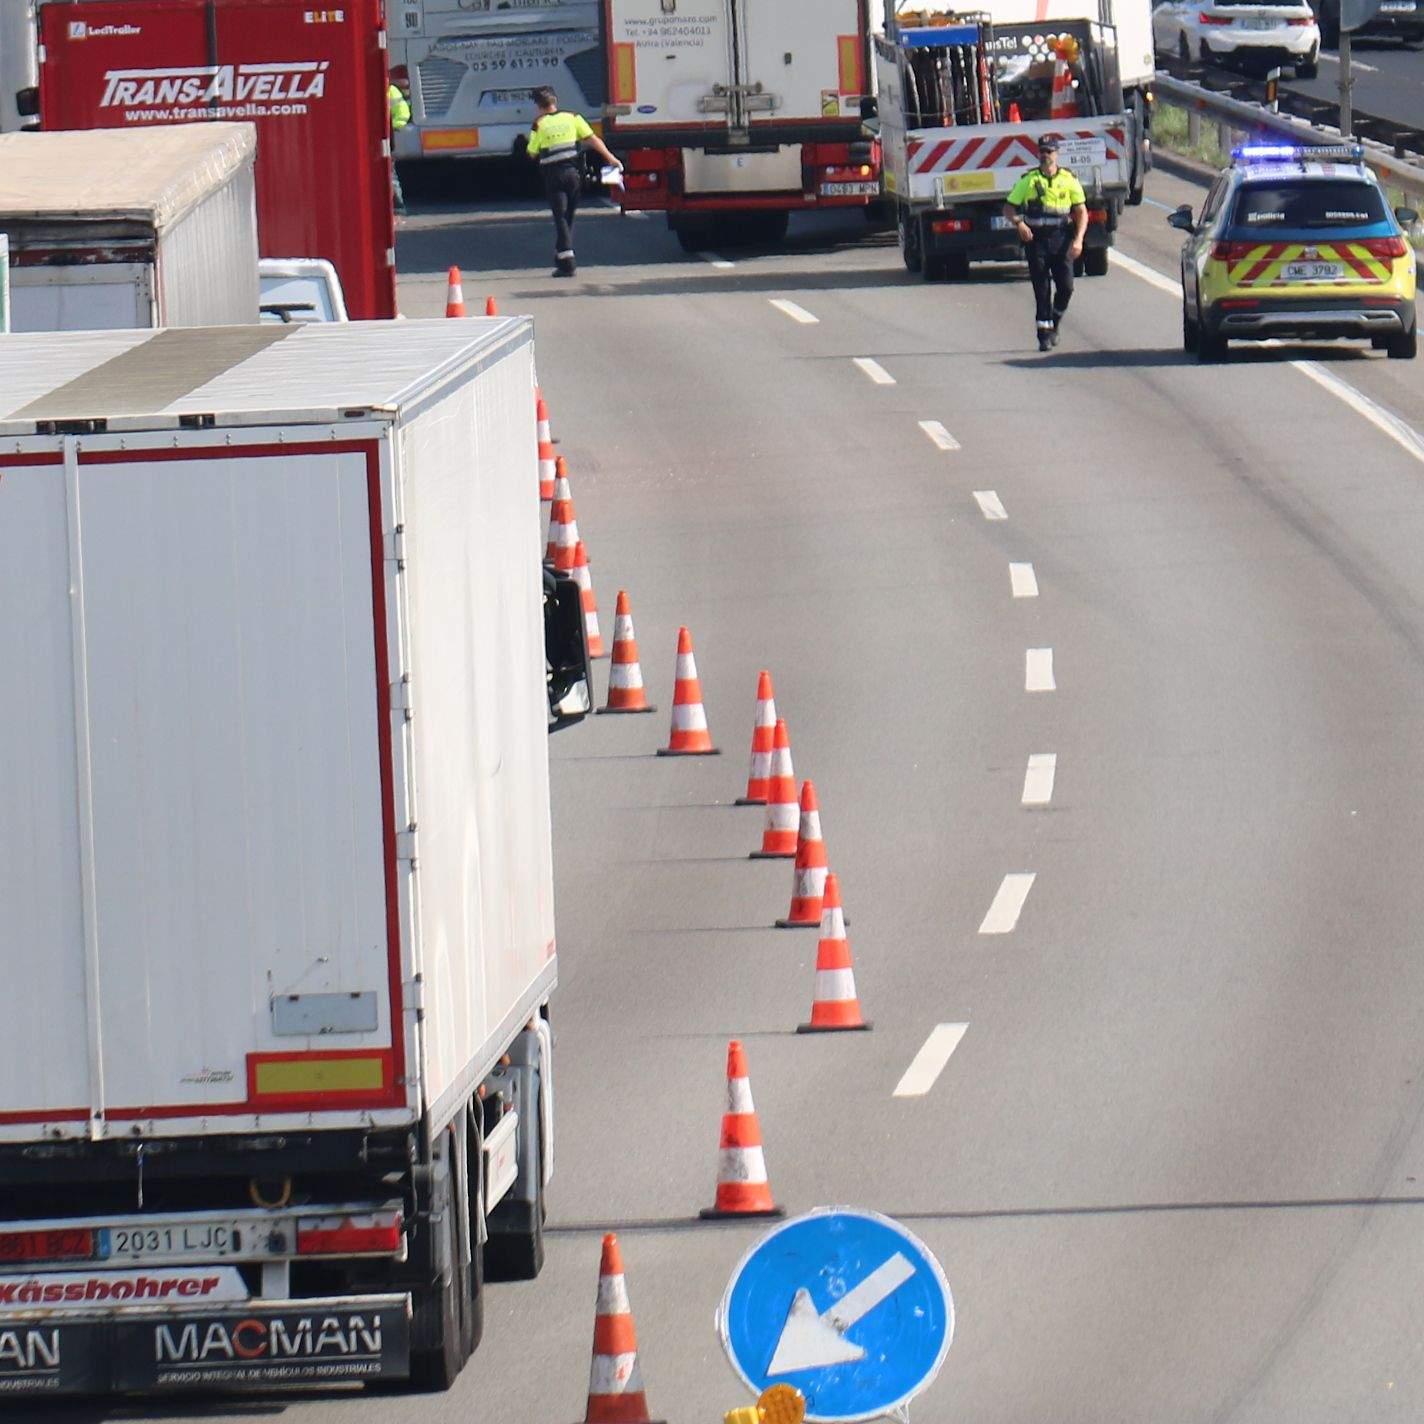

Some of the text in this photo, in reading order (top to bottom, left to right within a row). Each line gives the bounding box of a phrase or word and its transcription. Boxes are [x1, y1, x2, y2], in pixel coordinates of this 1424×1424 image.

[125, 103, 307, 121] www.transavella.com
[116, 1226, 227, 1252] 2031 LJC
[154, 1316, 382, 1362] MACMAN
